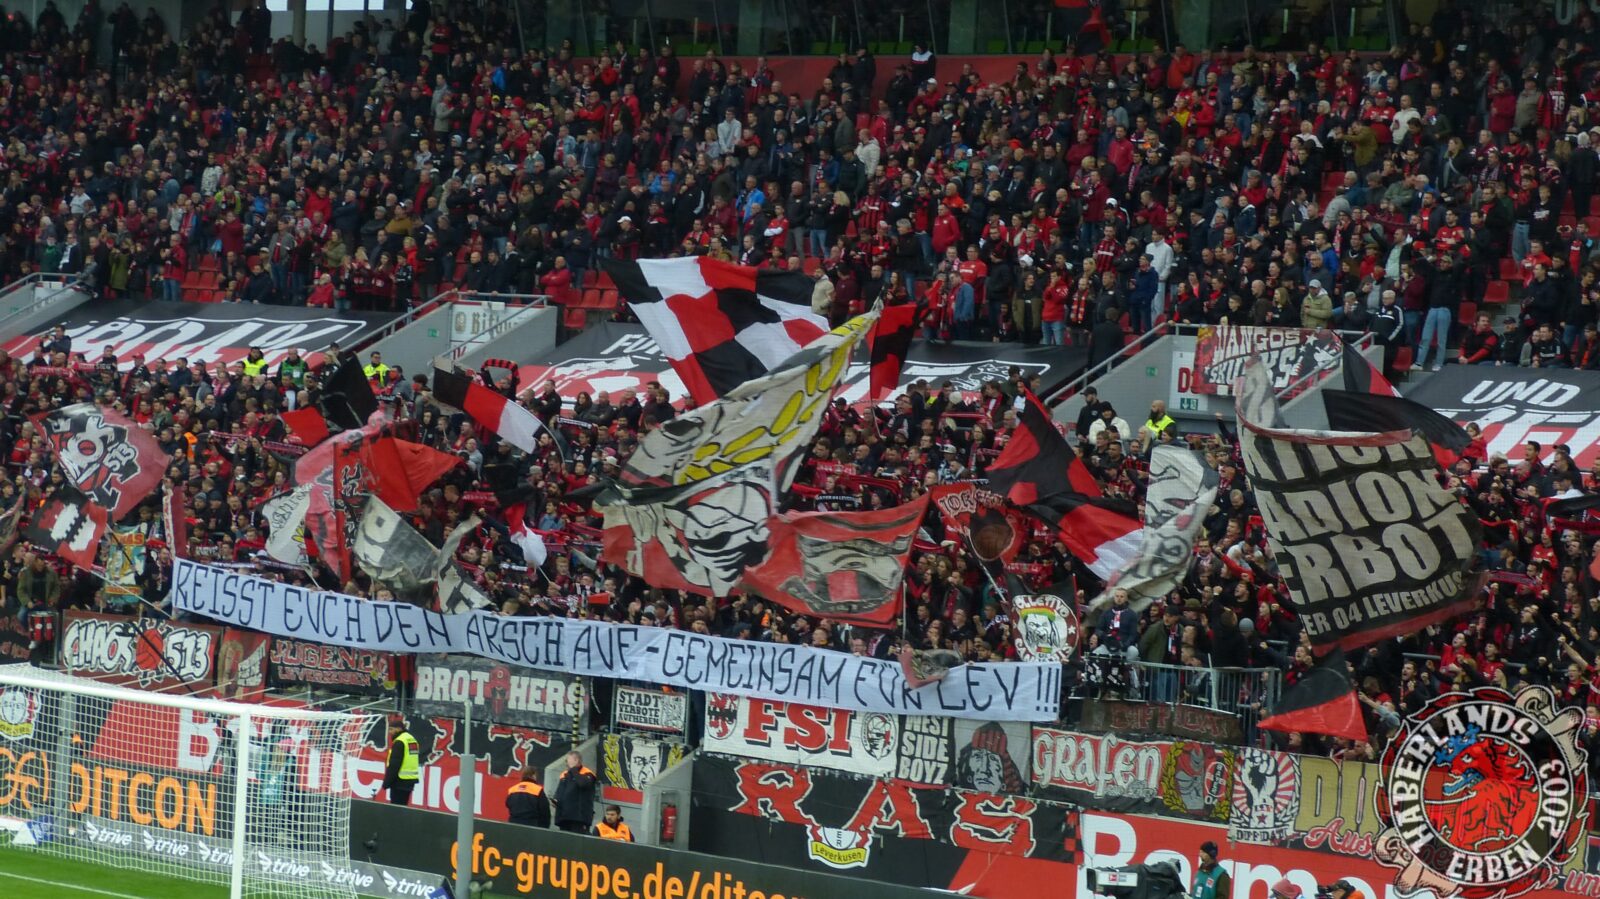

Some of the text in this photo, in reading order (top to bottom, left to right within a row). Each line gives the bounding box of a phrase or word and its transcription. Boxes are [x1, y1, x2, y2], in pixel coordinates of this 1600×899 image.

[1461, 378, 1581, 408] UND
[103, 442, 139, 472] 513
[1332, 604, 1363, 629] 04
[175, 562, 275, 629] REISST
[373, 603, 452, 648] DEN
[466, 614, 564, 667] ARSCH
[661, 632, 847, 704] GEMEINSAM
[63, 619, 136, 675] CHAOS
[164, 627, 212, 682] 513
[618, 690, 661, 708] STADT
[618, 703, 661, 718] VERBOTE
[617, 712, 661, 726] AUFHEBEN
[742, 697, 857, 757] FSI
[901, 731, 950, 762] SIDE
[897, 756, 949, 785] BOYZ
[69, 762, 218, 837] DITCON
[100, 826, 132, 847] trive
[154, 833, 189, 857] trive
[210, 844, 236, 866] triv
[814, 843, 863, 860] Leverkusen
[271, 854, 310, 878] trive
[336, 864, 374, 888] trive
[397, 874, 436, 897] trive
